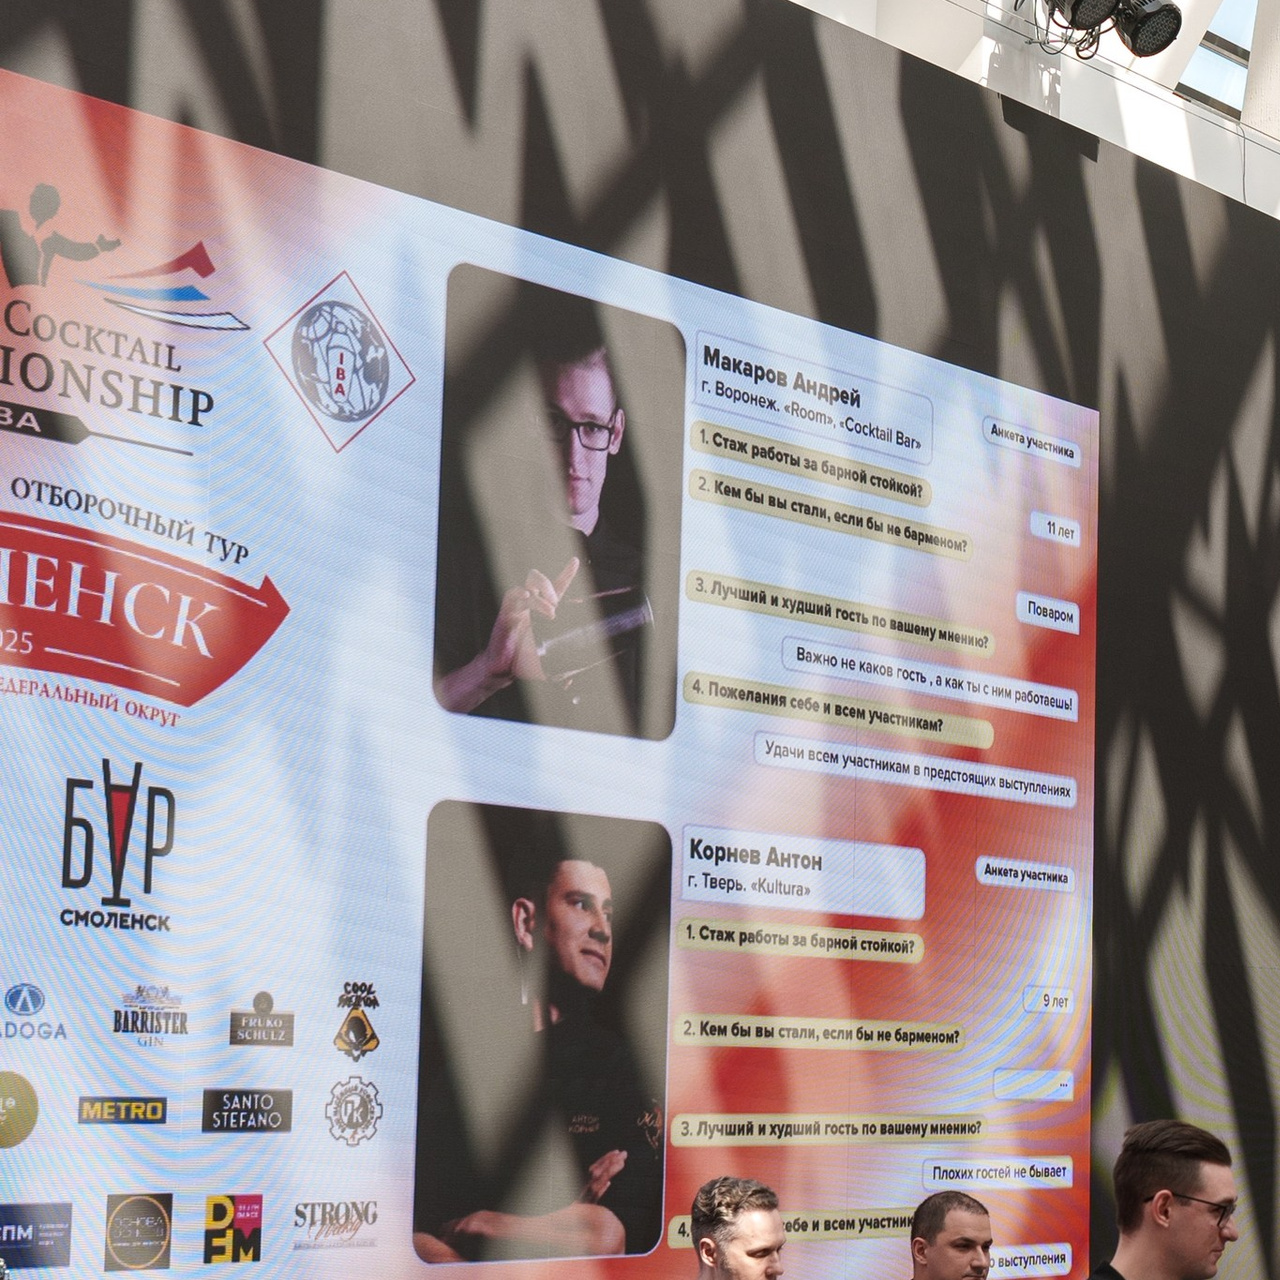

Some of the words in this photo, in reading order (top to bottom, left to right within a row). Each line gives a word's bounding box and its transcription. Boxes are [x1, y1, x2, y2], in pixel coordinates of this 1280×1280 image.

[4, 299, 181, 373] COCKTAIL
[335, 352, 345, 396] IBA
[703, 345, 788, 387] Макаров
[793, 372, 861, 409] Андрей
[715, 381, 780, 413] Воронеж.
[840, 417, 893, 444] «Cocktail
[896, 431, 921, 450] Bar»
[991, 423, 1025, 444] Анкета
[1026, 436, 1074, 459] участника
[712, 432, 748, 454] Стаж
[752, 444, 800, 467] работы
[821, 460, 867, 484] барной
[870, 475, 923, 498] стойкой?
[11, 477, 195, 546] ОТБОРОЧНЫЙ
[204, 531, 249, 564] ТУР
[714, 480, 741, 499] Кем
[791, 500, 831, 523] стали,
[834, 511, 864, 528] если
[903, 526, 968, 553] барменом?
[1058, 526, 1075, 539] лет
[711, 580, 767, 605] Лучший
[781, 597, 832, 618] худший
[835, 607, 869, 625] гость
[889, 618, 937, 641] вашему
[938, 629, 989, 649] мнению?
[1028, 600, 1074, 623] Поваром
[796, 646, 838, 667] Важно
[859, 660, 893, 677] каков
[896, 666, 927, 684] гость
[945, 677, 964, 691] как
[991, 687, 1012, 700] ним
[1014, 690, 1073, 711] работаешь!
[125, 701, 181, 728] ОКРУГ
[709, 681, 787, 708] Пожелания
[789, 695, 820, 712] себе
[835, 704, 865, 720] всем
[868, 710, 944, 732] участникам?
[765, 740, 805, 760] Удачи
[808, 746, 839, 764] всем
[842, 751, 910, 777] участникам
[924, 765, 997, 787] предстоящих
[999, 777, 1071, 799] выступлениях
[690, 838, 760, 866] Корнев
[766, 847, 822, 871] Антон
[702, 872, 747, 894] Тверь.
[751, 878, 811, 897] «Kultura»
[984, 863, 1018, 880] Анкета
[1020, 867, 1069, 885] участника
[60, 908, 171, 931] СМОЛЕНСК
[699, 925, 735, 943] Стаж
[739, 929, 789, 947] работы
[810, 933, 857, 952] барной
[860, 936, 914, 954] стойкой?
[344, 982, 376, 995] COOL
[1052, 996, 1069, 1009] лет
[114, 1010, 189, 1035] BARRISTER
[237, 1029, 285, 1041] SCHULZ
[241, 1017, 283, 1028] FRUKO
[700, 1021, 727, 1036] Кем
[778, 1026, 820, 1041] стали,
[823, 1027, 853, 1040] если
[894, 1030, 960, 1045] барменом?
[82, 1102, 163, 1120] METRO
[223, 1094, 274, 1110] SANTO
[212, 1112, 282, 1129] STEFANO
[697, 1120, 754, 1139] Лучший
[769, 1121, 821, 1139] худший
[824, 1123, 858, 1136] гость
[880, 1123, 928, 1138] вашему
[930, 1121, 982, 1135] мнению?
[932, 1166, 973, 1180] Плохих
[976, 1165, 1011, 1179] гостей
[1029, 1164, 1067, 1178] бывает
[294, 1201, 377, 1228] STRONG
[823, 1218, 855, 1232] всем
[998, 1253, 1066, 1269] выступления
